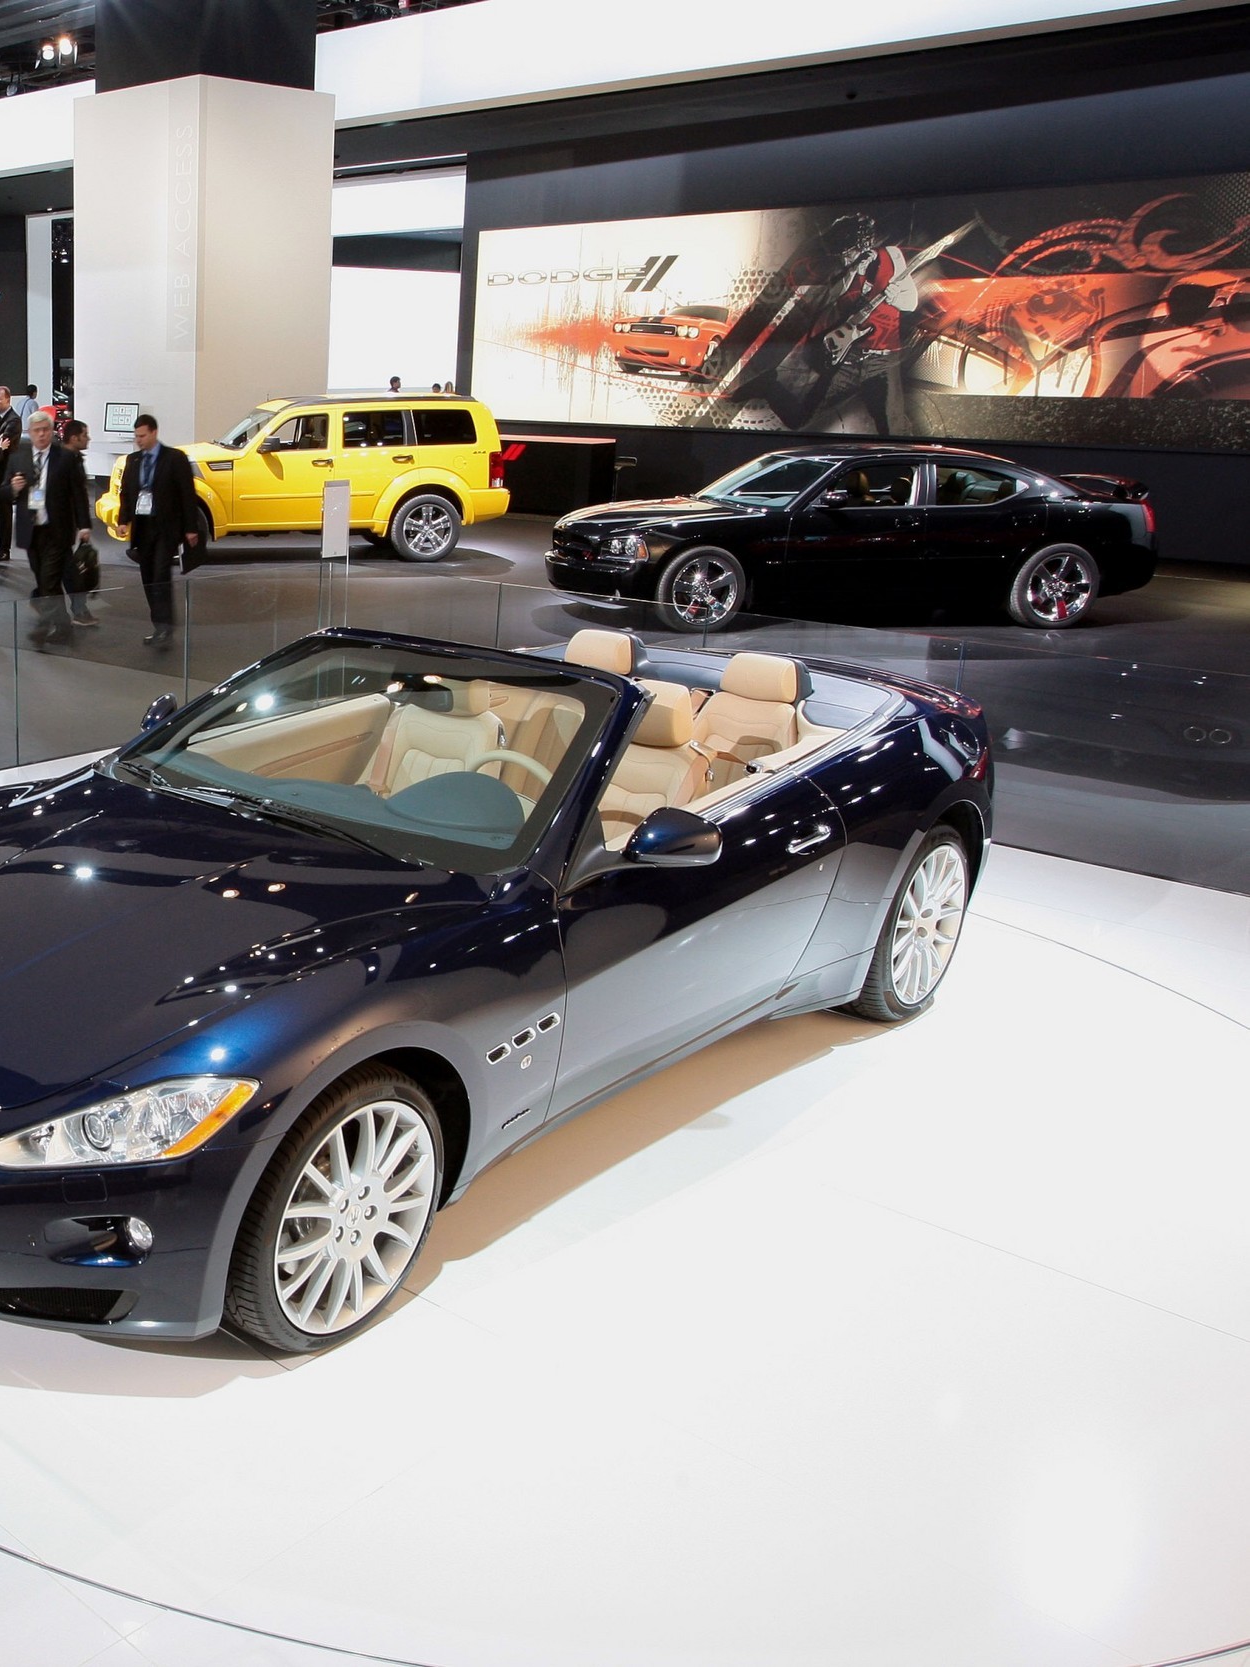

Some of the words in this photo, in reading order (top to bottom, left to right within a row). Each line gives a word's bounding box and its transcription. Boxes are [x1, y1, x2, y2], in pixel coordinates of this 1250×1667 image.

[174, 124, 194, 258] ACCESS
[173, 273, 191, 340] WEB
[487, 264, 647, 287] DODGE
